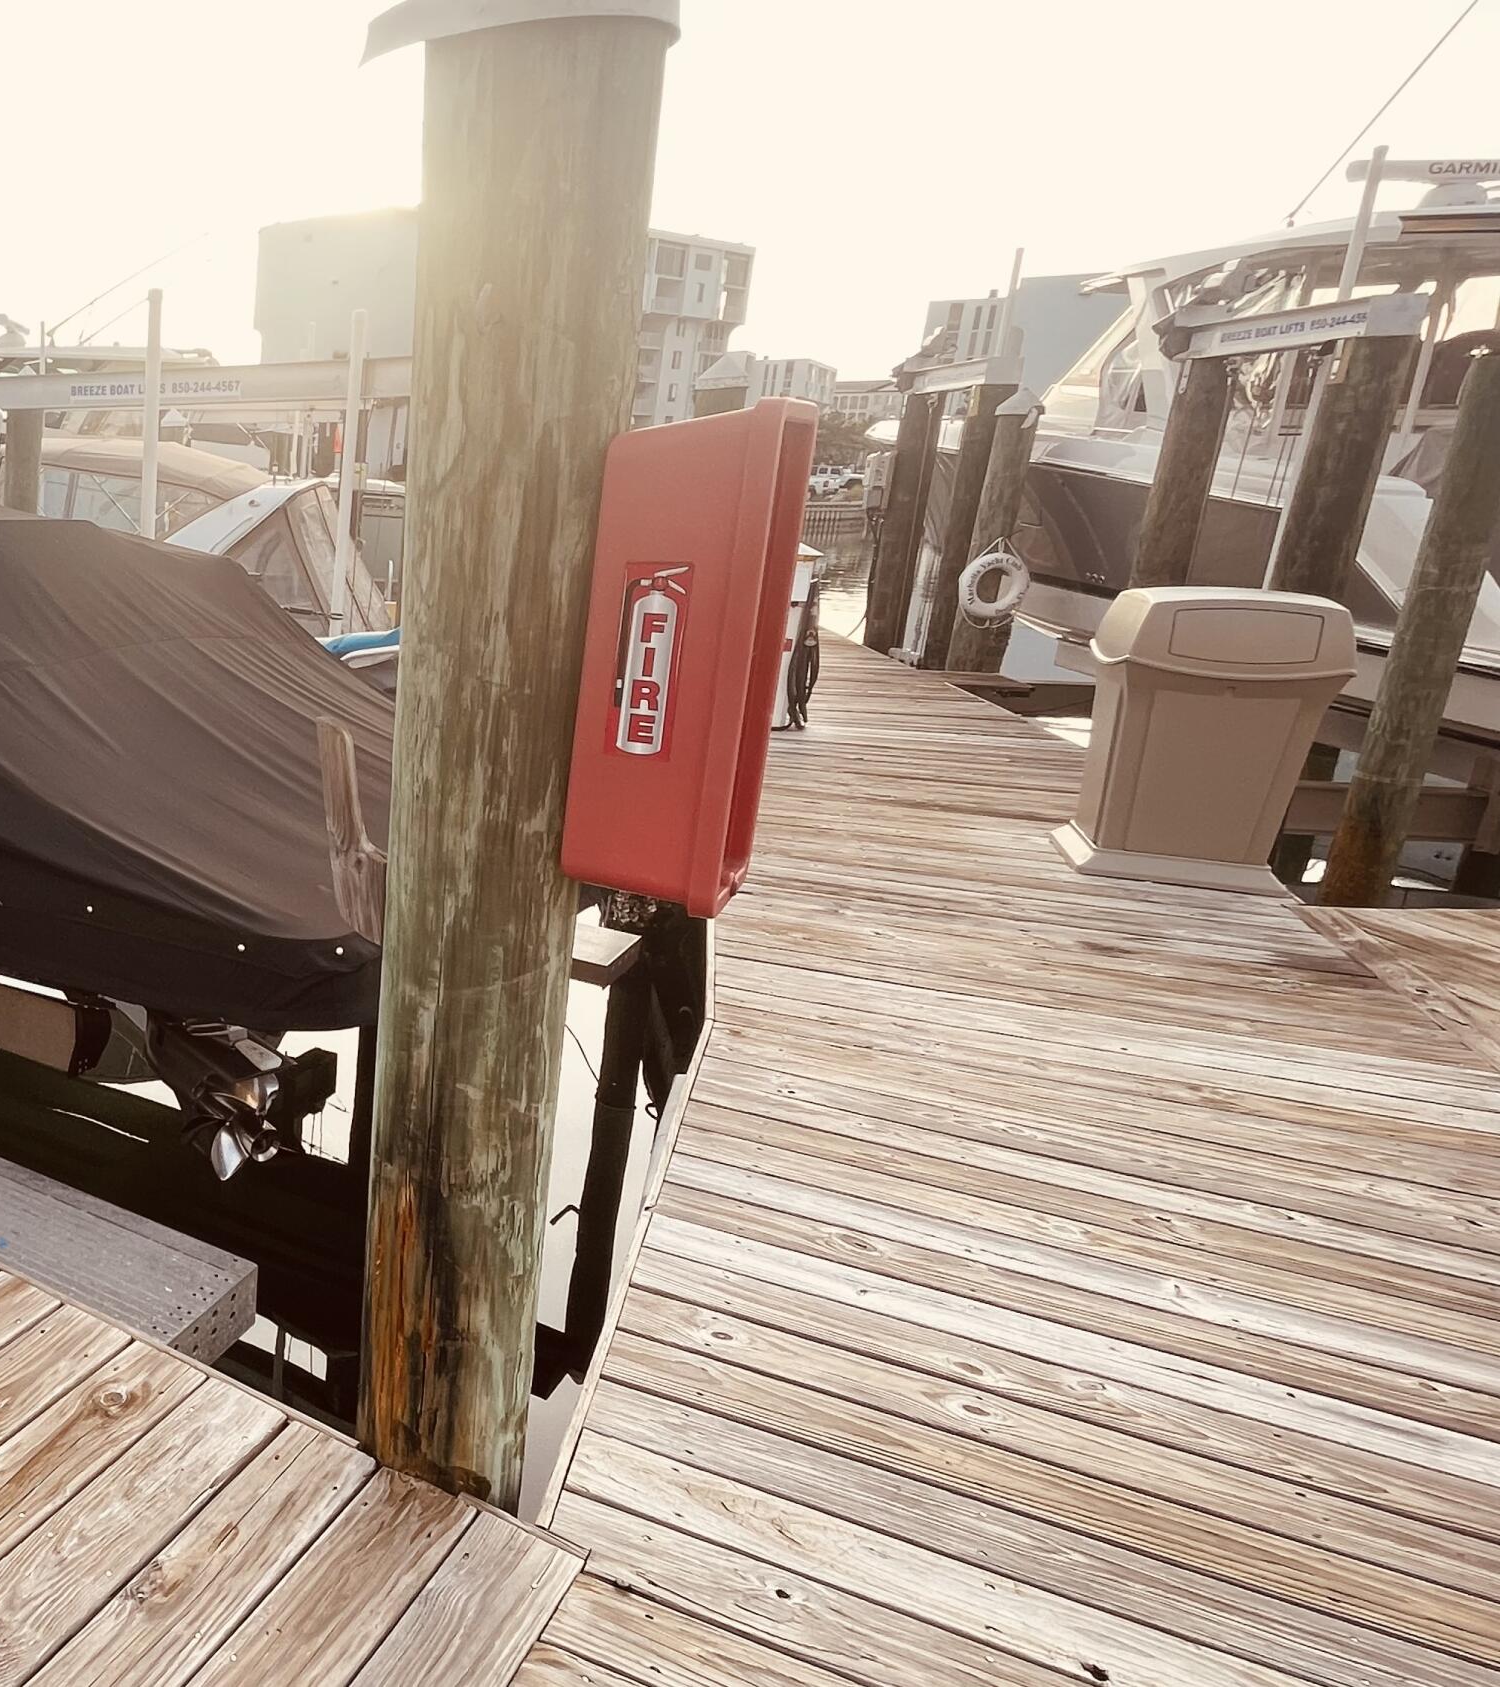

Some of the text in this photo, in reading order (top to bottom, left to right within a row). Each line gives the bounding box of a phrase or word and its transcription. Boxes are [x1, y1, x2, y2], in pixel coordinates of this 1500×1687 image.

[1428, 161, 1500, 175] GARMI
[1220, 312, 1368, 344] BREEZE BOAT LIFTS 850-244-456
[70, 385, 107, 397] BREEZE
[110, 384, 135, 396] BOAT
[171, 380, 241, 394] 850-244-4567
[626, 612, 669, 745] FIRE
